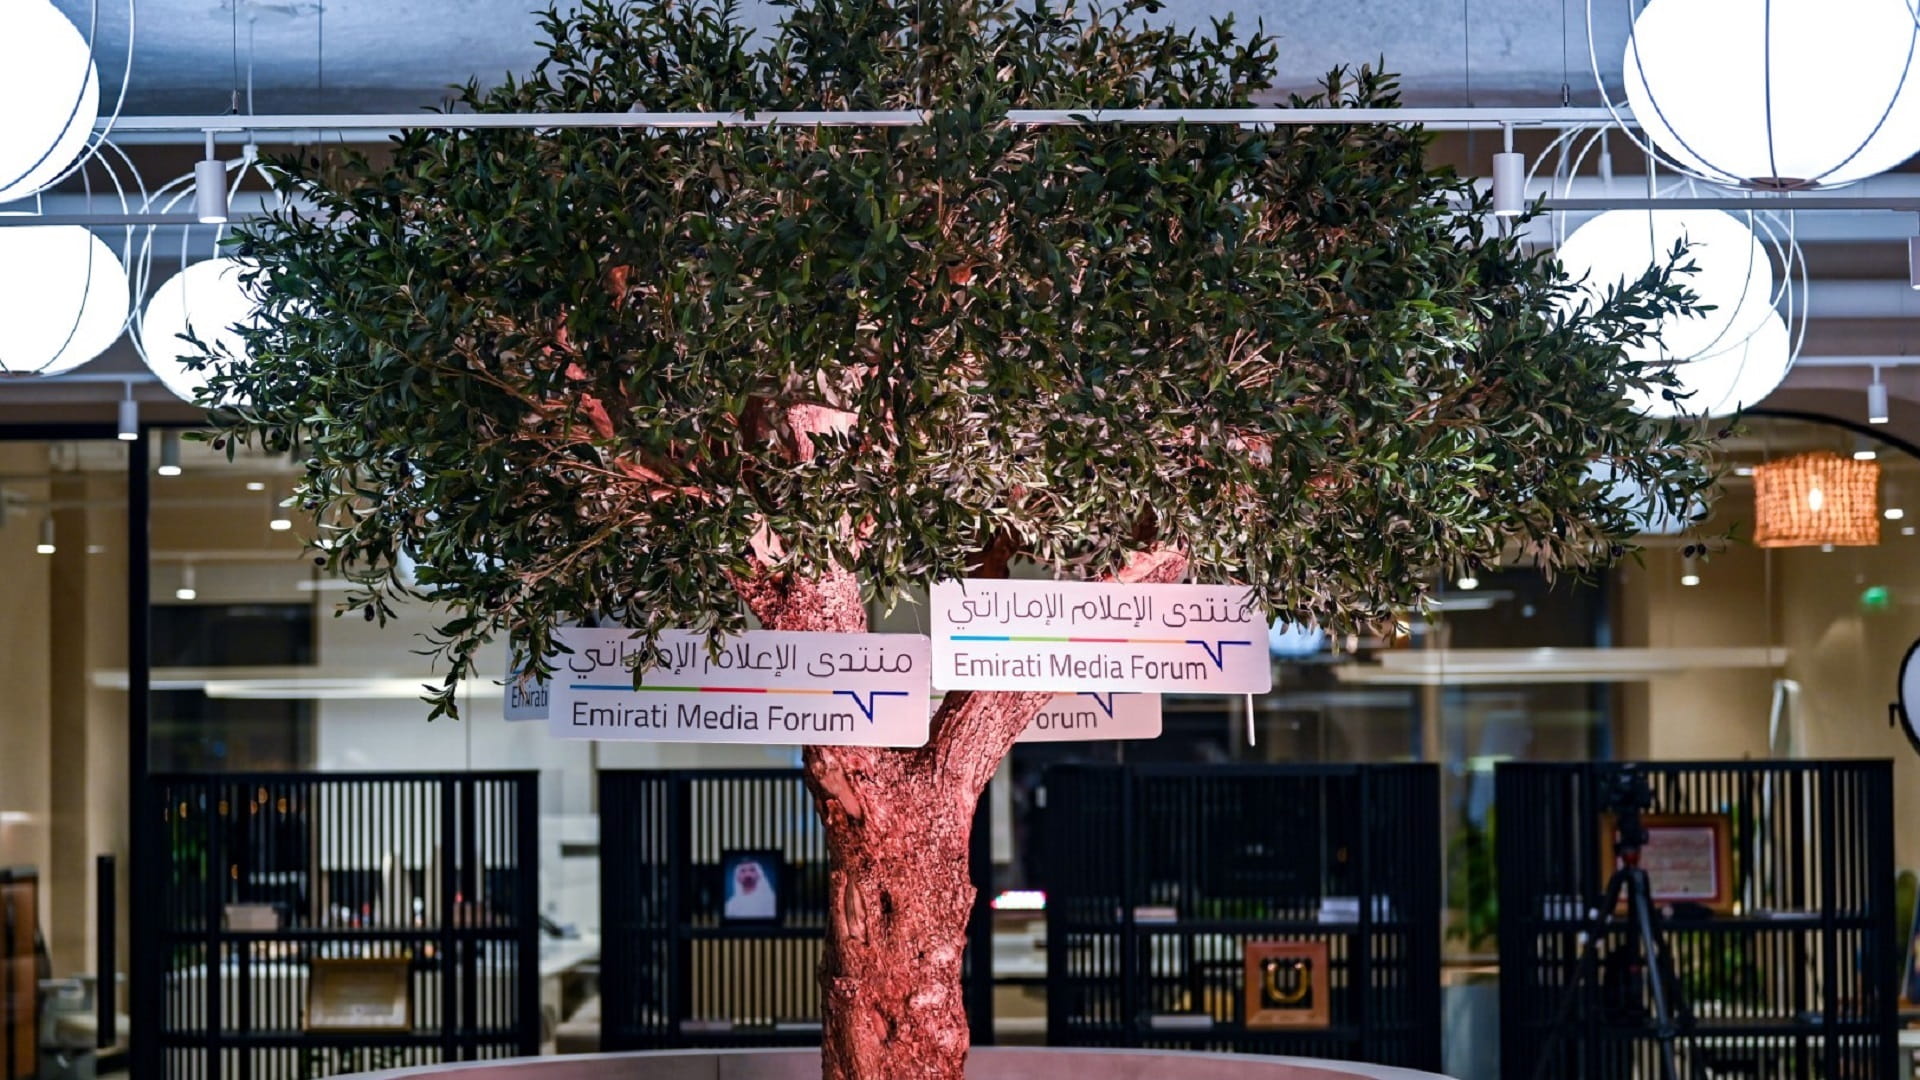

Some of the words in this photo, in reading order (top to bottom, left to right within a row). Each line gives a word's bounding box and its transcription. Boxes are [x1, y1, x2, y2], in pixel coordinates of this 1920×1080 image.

[947, 591, 1064, 630] الإماراتي
[1071, 594, 1152, 628] الإعلام
[704, 643, 797, 677] الإعلام
[807, 647, 913, 678] منتدى
[954, 652, 1041, 677] Emirati
[1049, 653, 1124, 679] Media
[1131, 655, 1208, 680] Forum
[572, 701, 667, 728] Emirati
[677, 704, 759, 730] Media
[768, 706, 855, 732] Forum
[1033, 711, 1098, 730] orum
